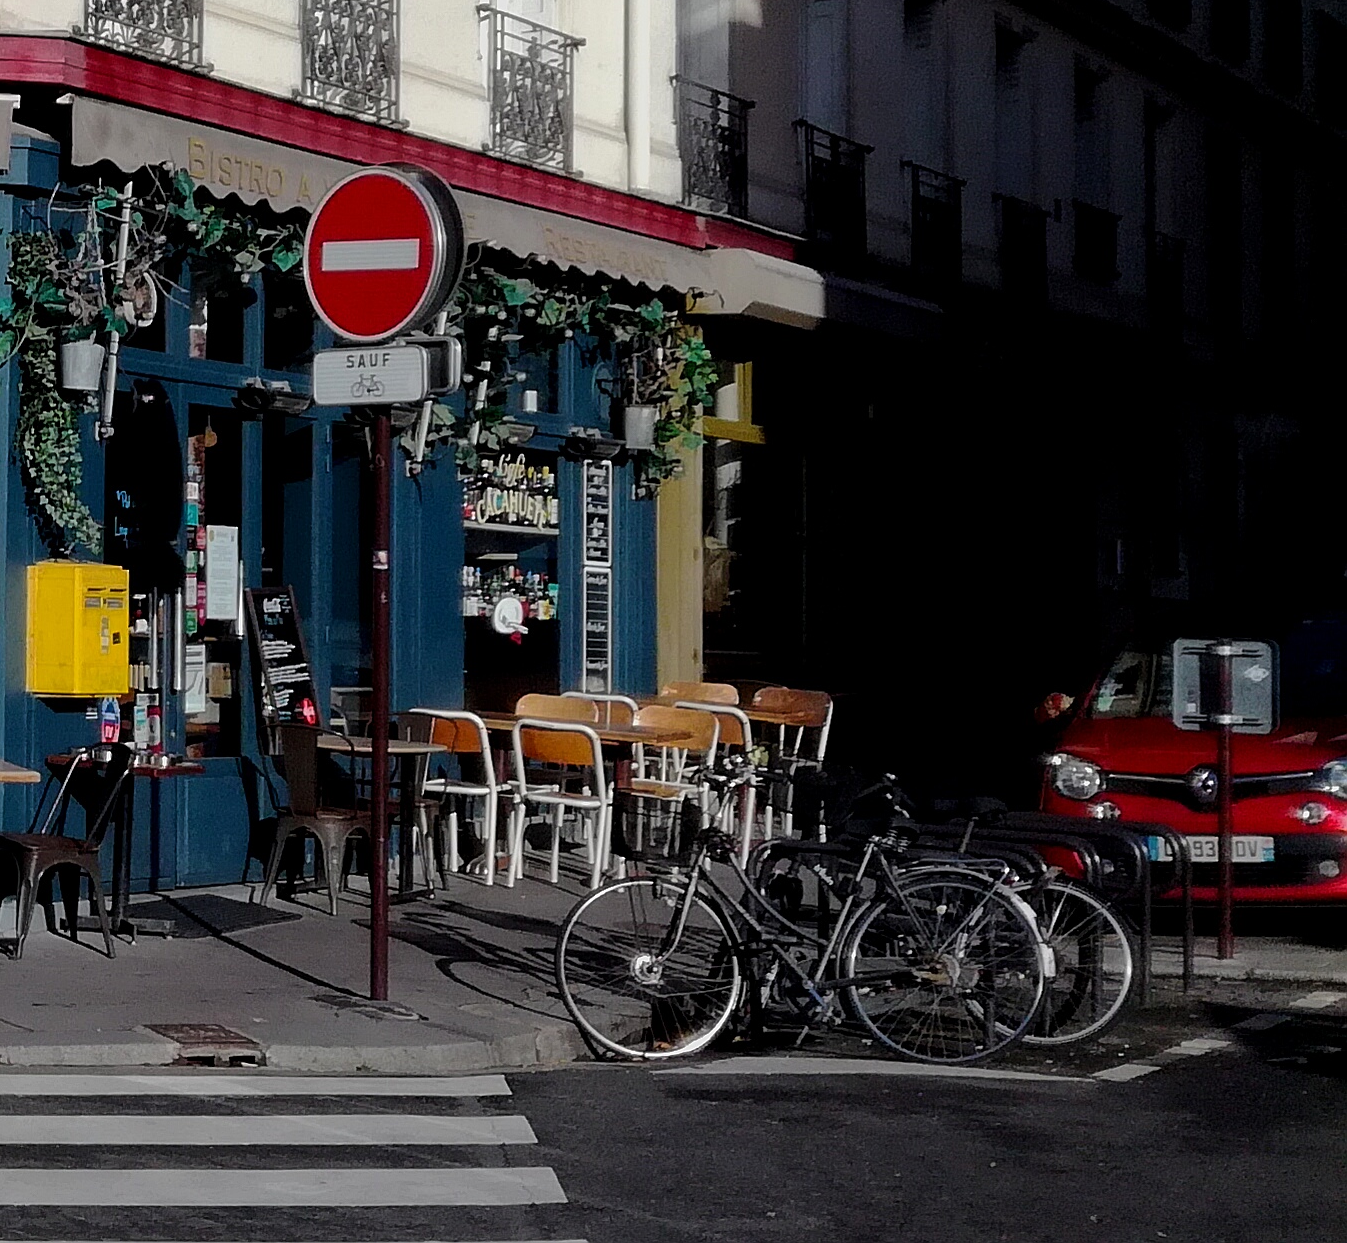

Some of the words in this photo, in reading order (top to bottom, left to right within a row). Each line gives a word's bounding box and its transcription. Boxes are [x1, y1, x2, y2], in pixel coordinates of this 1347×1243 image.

[188, 136, 285, 198] BISTRO
[296, 173, 314, 204] A
[346, 353, 391, 369] SAUF
